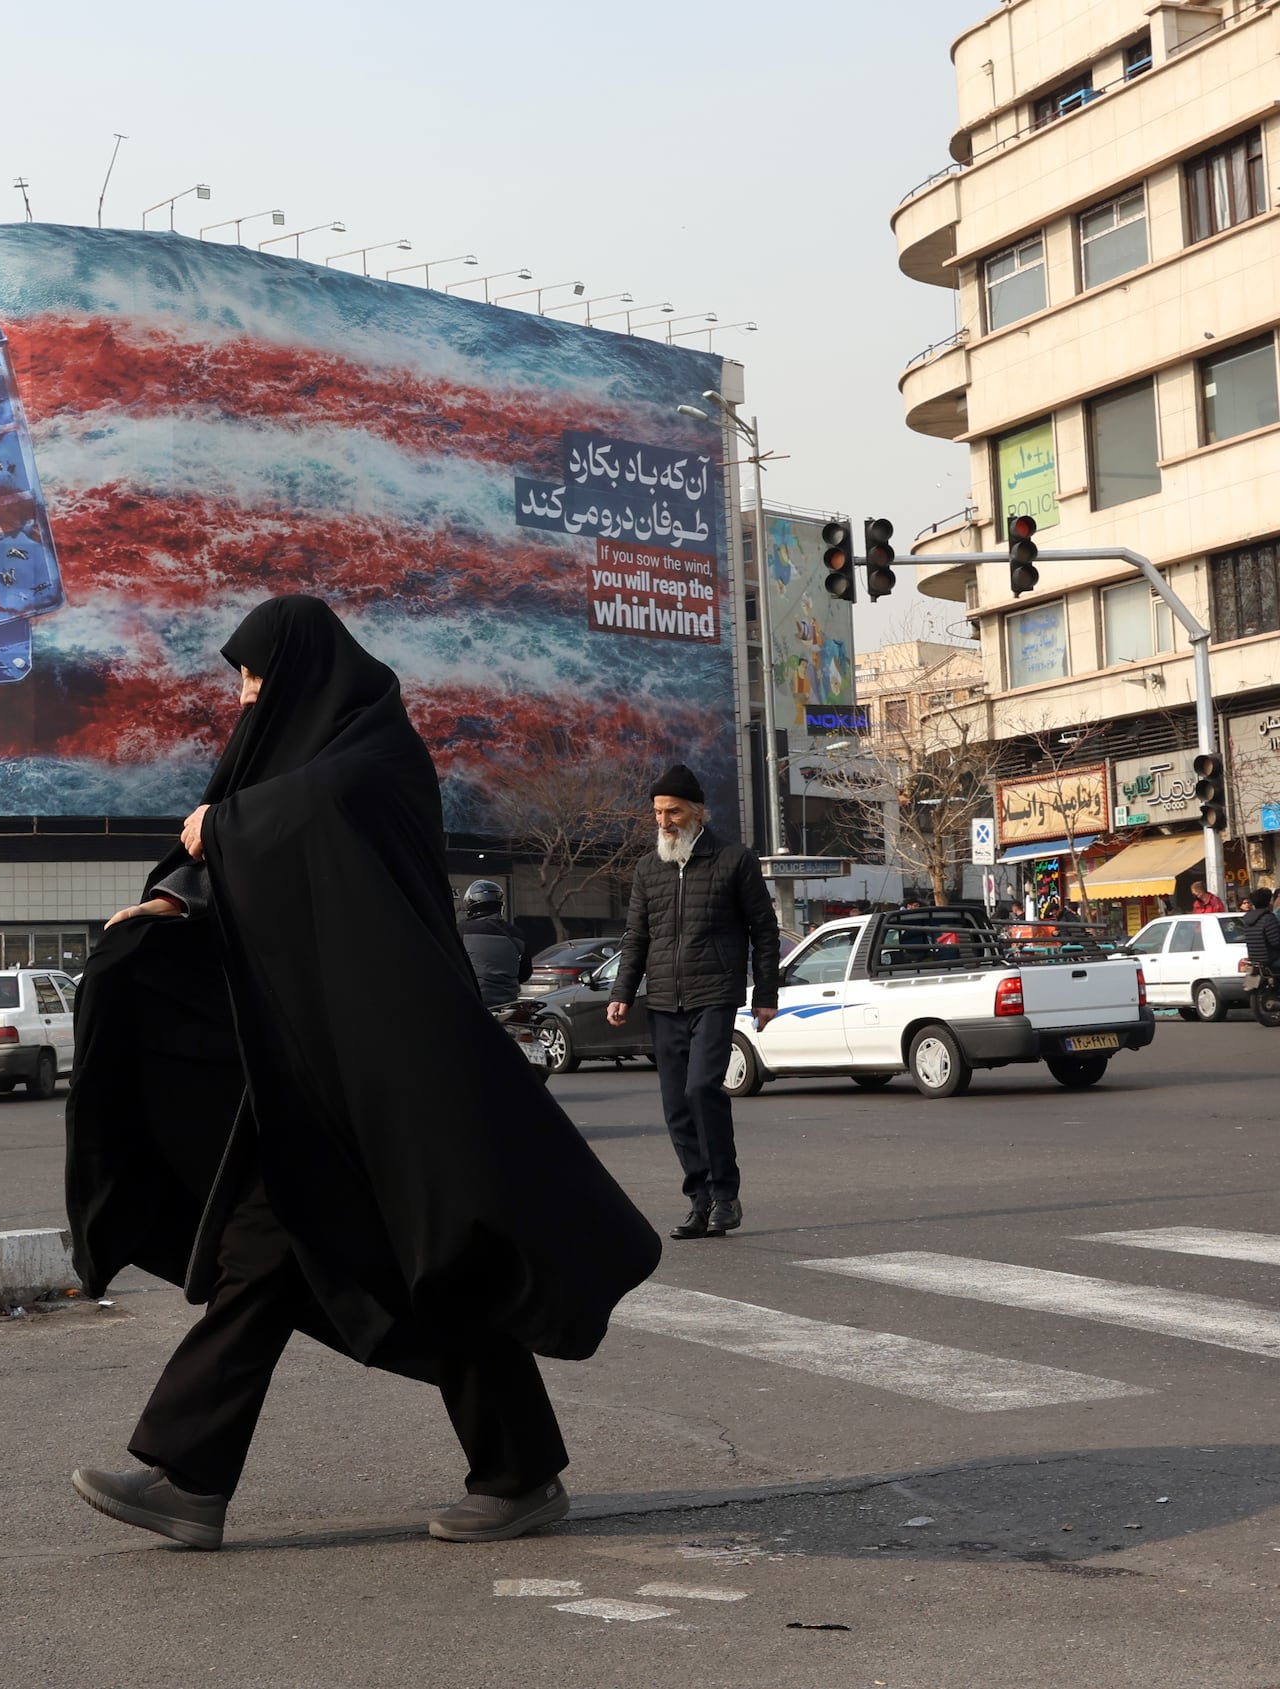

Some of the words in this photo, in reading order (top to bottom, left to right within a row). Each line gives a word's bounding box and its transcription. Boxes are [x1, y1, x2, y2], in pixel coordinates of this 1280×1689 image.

[570, 441, 620, 488] بکارد
[625, 451, 658, 495] باد
[659, 459, 688, 490] که
[685, 456, 710, 500] آن
[1007, 491, 1059, 516] POLICE
[634, 501, 709, 548] طوفان
[600, 545, 610, 560] If
[612, 550, 634, 566] you
[636, 554, 661, 567] sow
[663, 555, 682, 571] the
[683, 559, 713, 577] wind,
[592, 569, 623, 591] you
[624, 571, 651, 592] will
[653, 578, 688, 601] reap
[689, 578, 714, 600] the
[593, 593, 715, 638] whirlwind
[806, 713, 867, 729] NOKIA
[772, 863, 806, 873] POLICE
